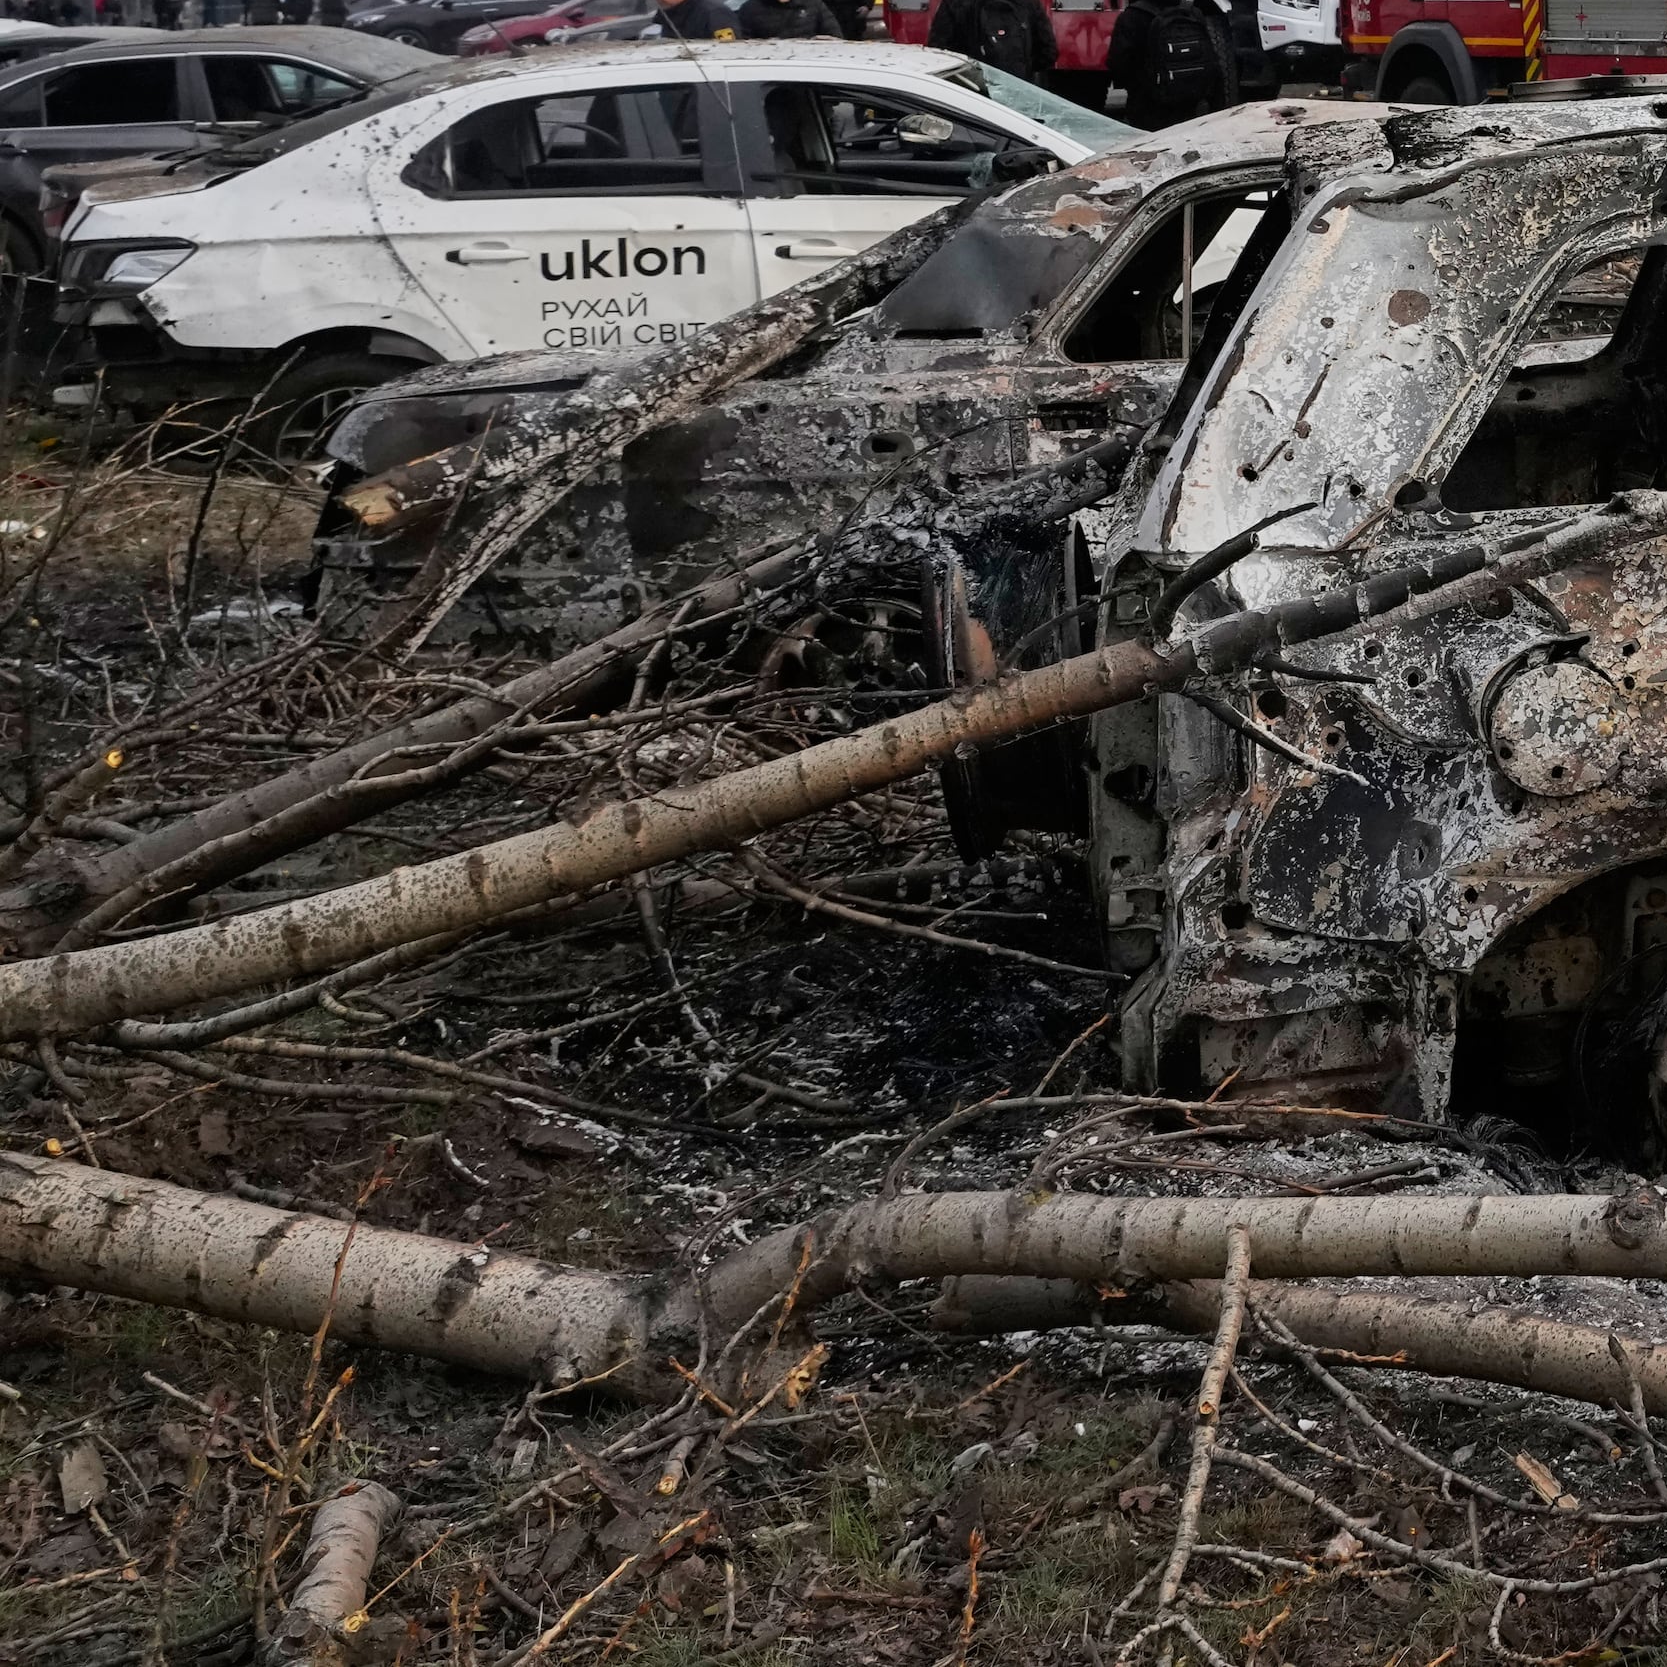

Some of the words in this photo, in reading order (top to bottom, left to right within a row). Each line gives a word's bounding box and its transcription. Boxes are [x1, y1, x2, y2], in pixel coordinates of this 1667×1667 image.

[540, 237, 706, 281] uklon
[541, 291, 648, 321] РУХАЙ
[543, 319, 622, 348] СВІЙ
